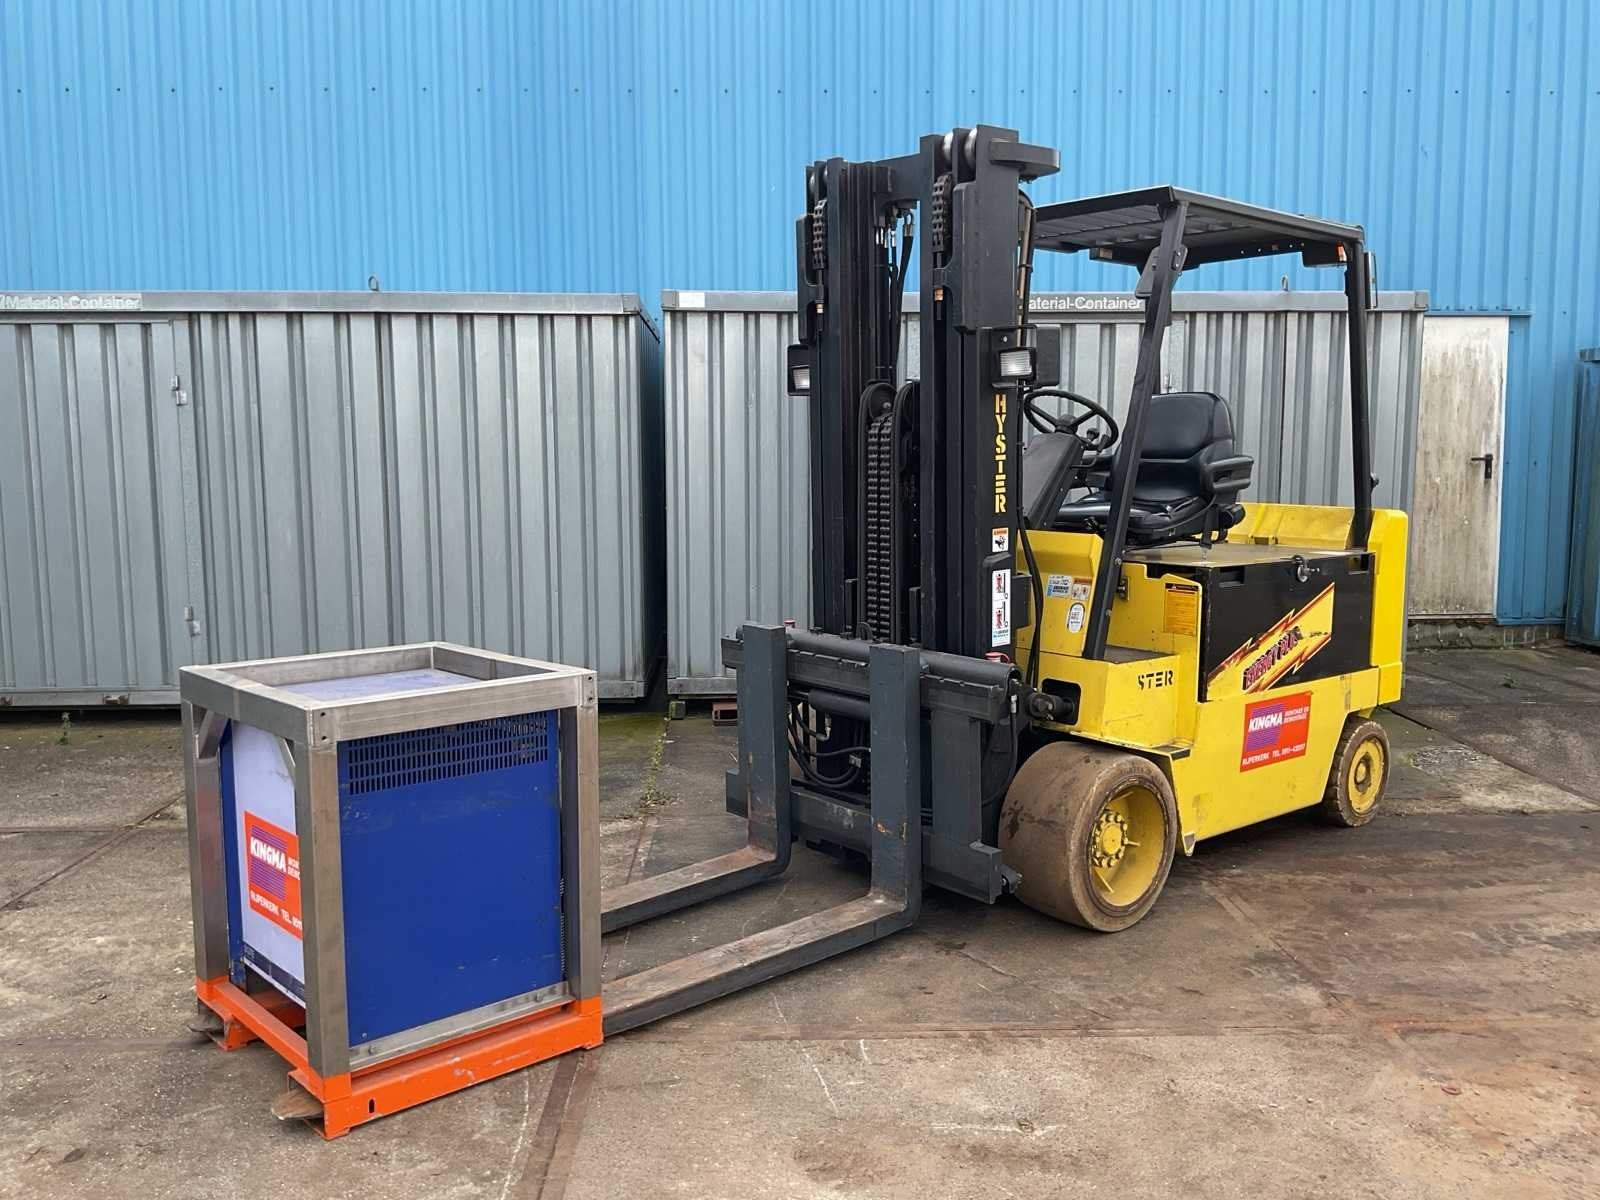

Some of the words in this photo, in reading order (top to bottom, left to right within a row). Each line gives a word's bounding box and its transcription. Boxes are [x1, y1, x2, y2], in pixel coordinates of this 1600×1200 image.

[1029, 296, 1142, 310] aterial-Container
[994, 393, 1007, 514] HYSTER
[1248, 713, 1284, 733] KINGMA
[250, 836, 287, 873] KINGMA
